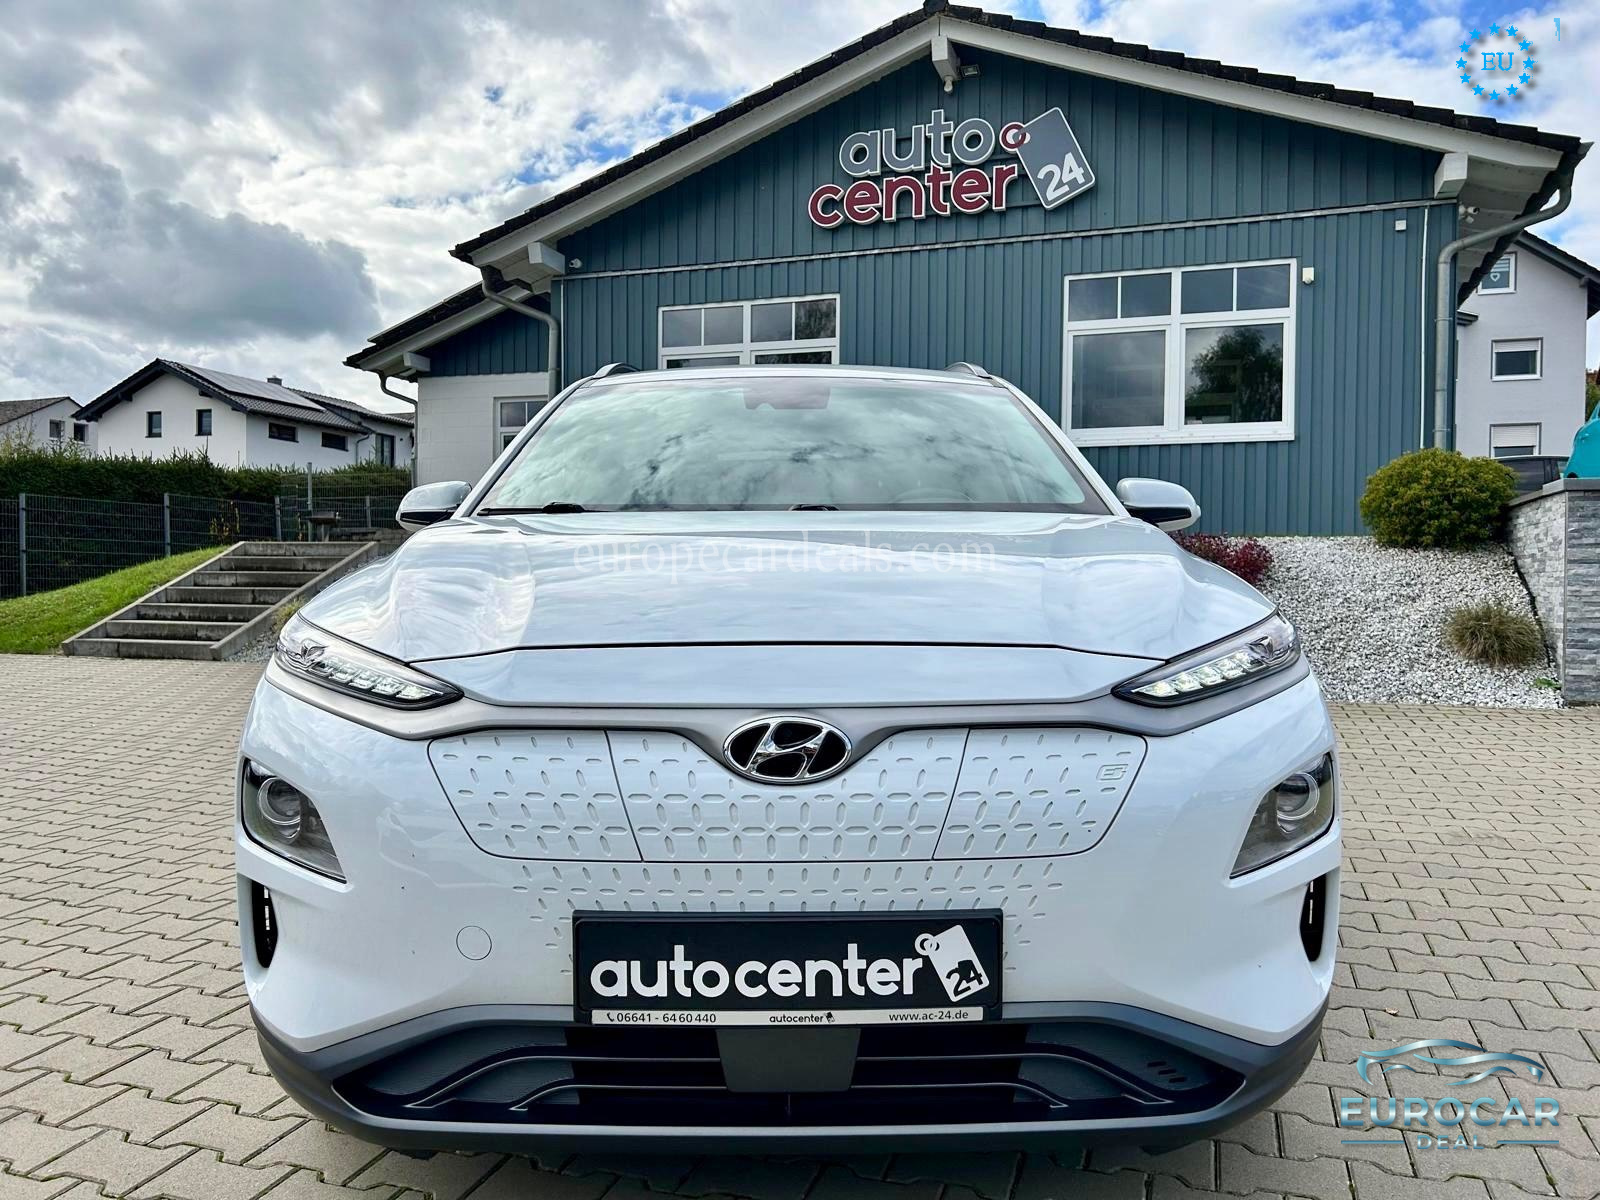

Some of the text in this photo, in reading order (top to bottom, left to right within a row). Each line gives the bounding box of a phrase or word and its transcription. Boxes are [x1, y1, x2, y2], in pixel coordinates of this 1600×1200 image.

[839, 109, 995, 176] auto
[1037, 152, 1085, 201] 24
[808, 160, 1017, 229] center
[945, 968, 984, 996] 24
[616, 1012, 651, 1023] 06641
[769, 1014, 824, 1023] autocenter
[889, 1010, 969, 1022] www.ac-24.de
